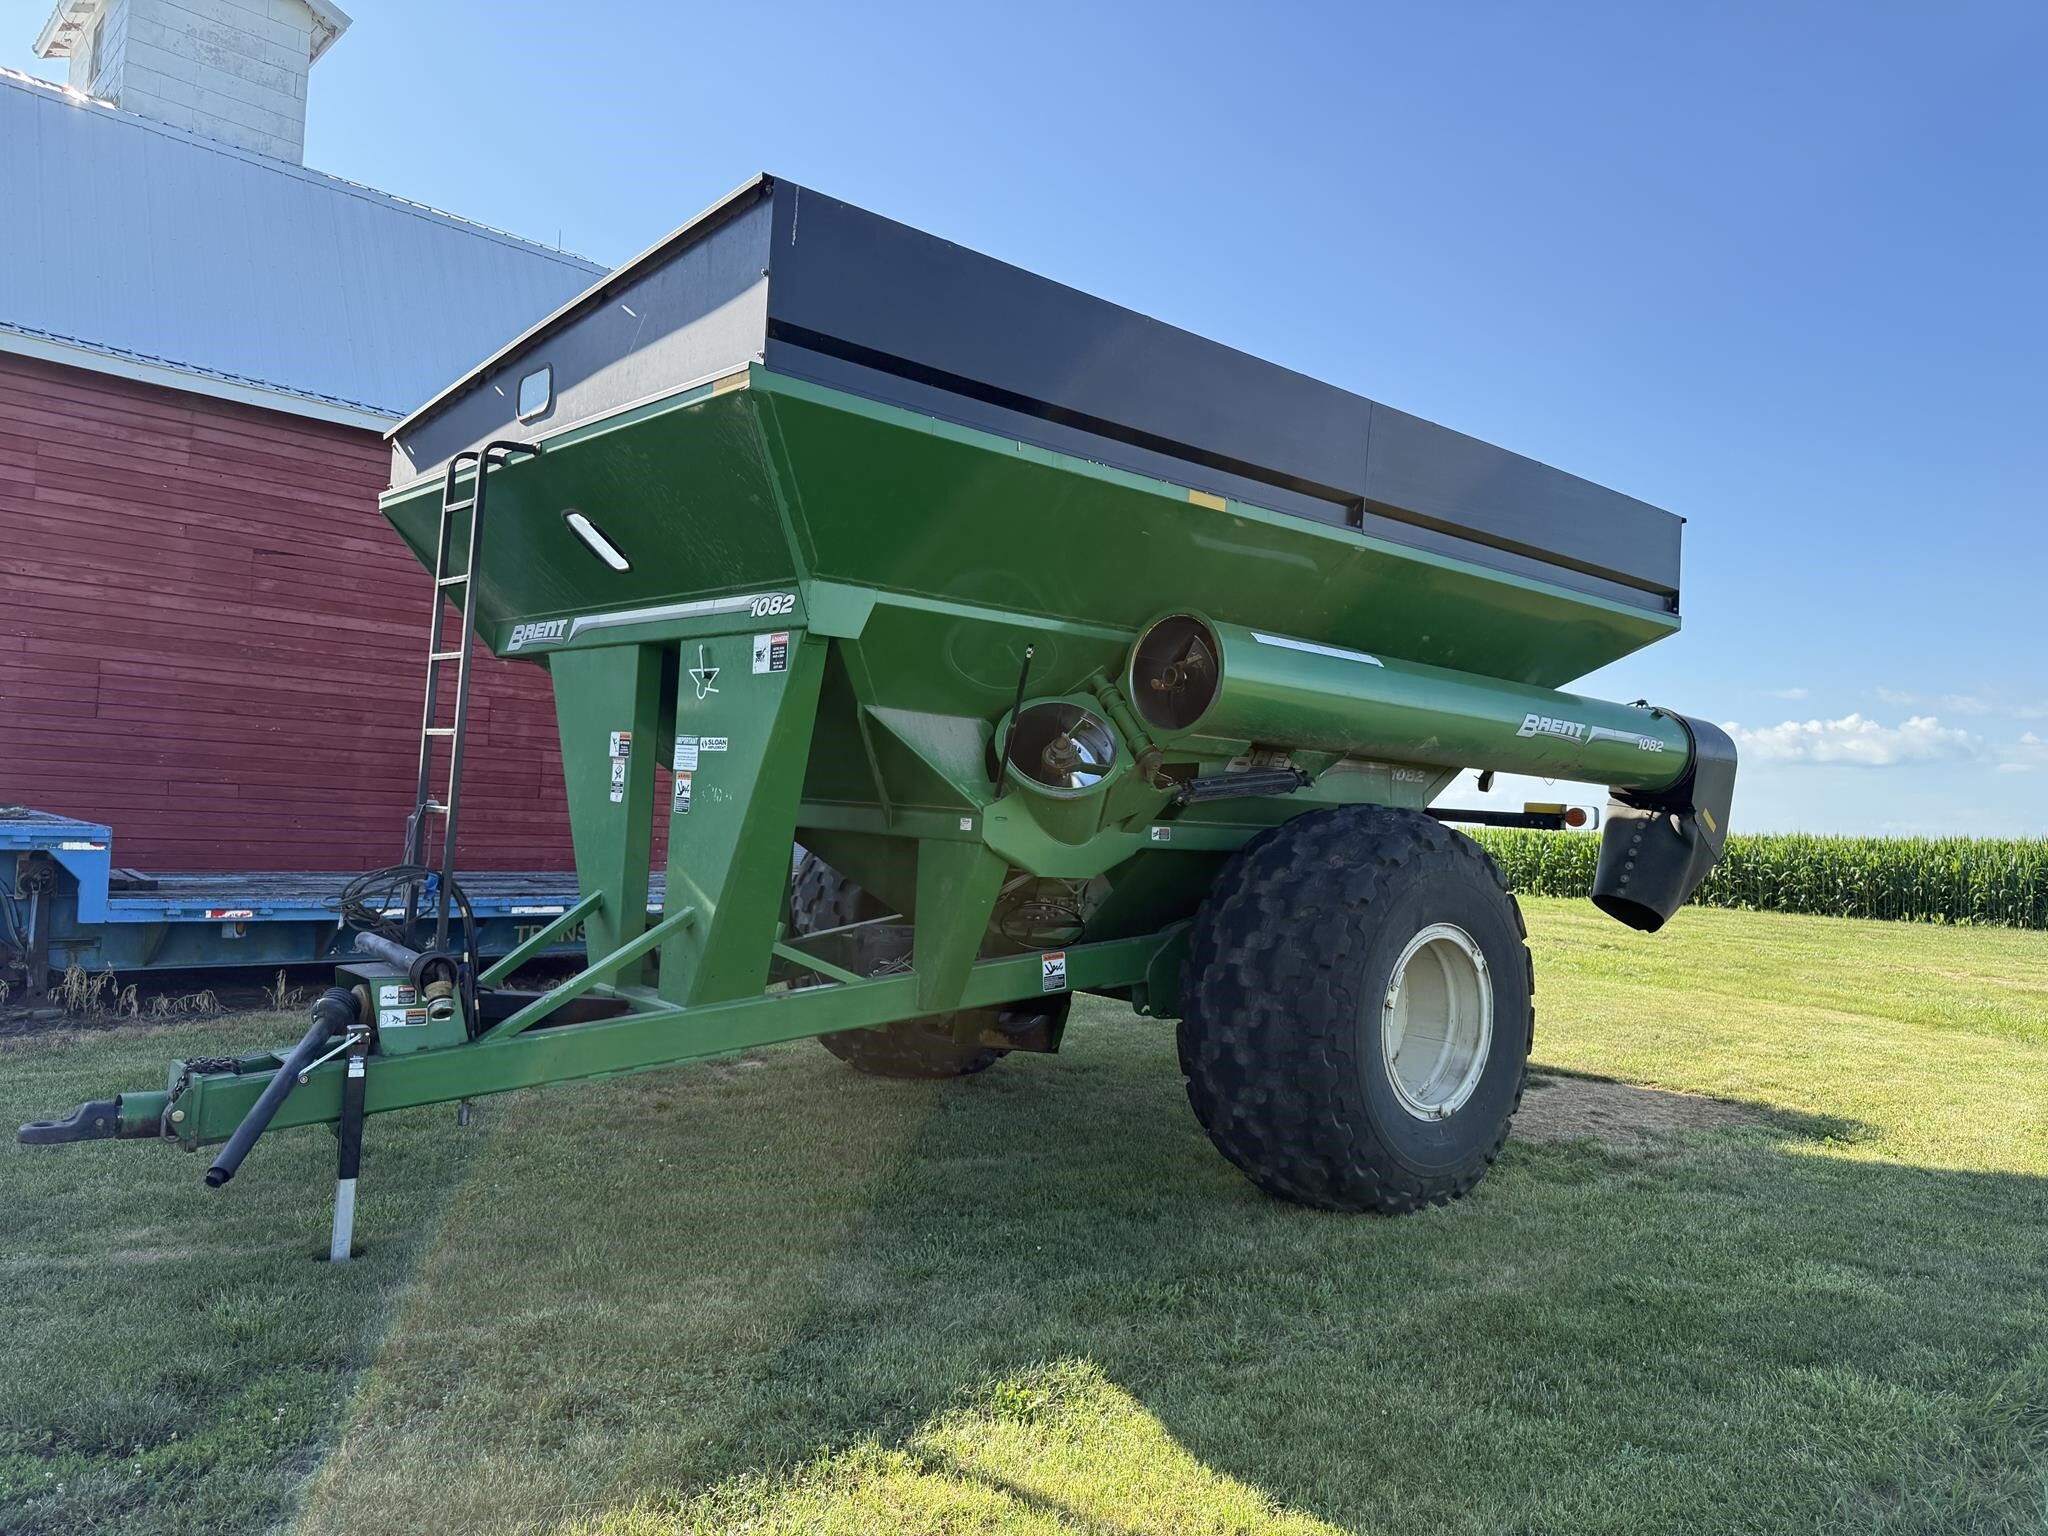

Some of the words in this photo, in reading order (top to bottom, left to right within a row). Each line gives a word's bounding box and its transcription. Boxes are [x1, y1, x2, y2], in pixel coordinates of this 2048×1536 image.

[507, 619, 569, 651] BRENT
[750, 594, 796, 618] 1082
[1516, 713, 1586, 738] BRENT
[1637, 736, 1665, 752] 1082
[1391, 766, 1426, 783] 1082
